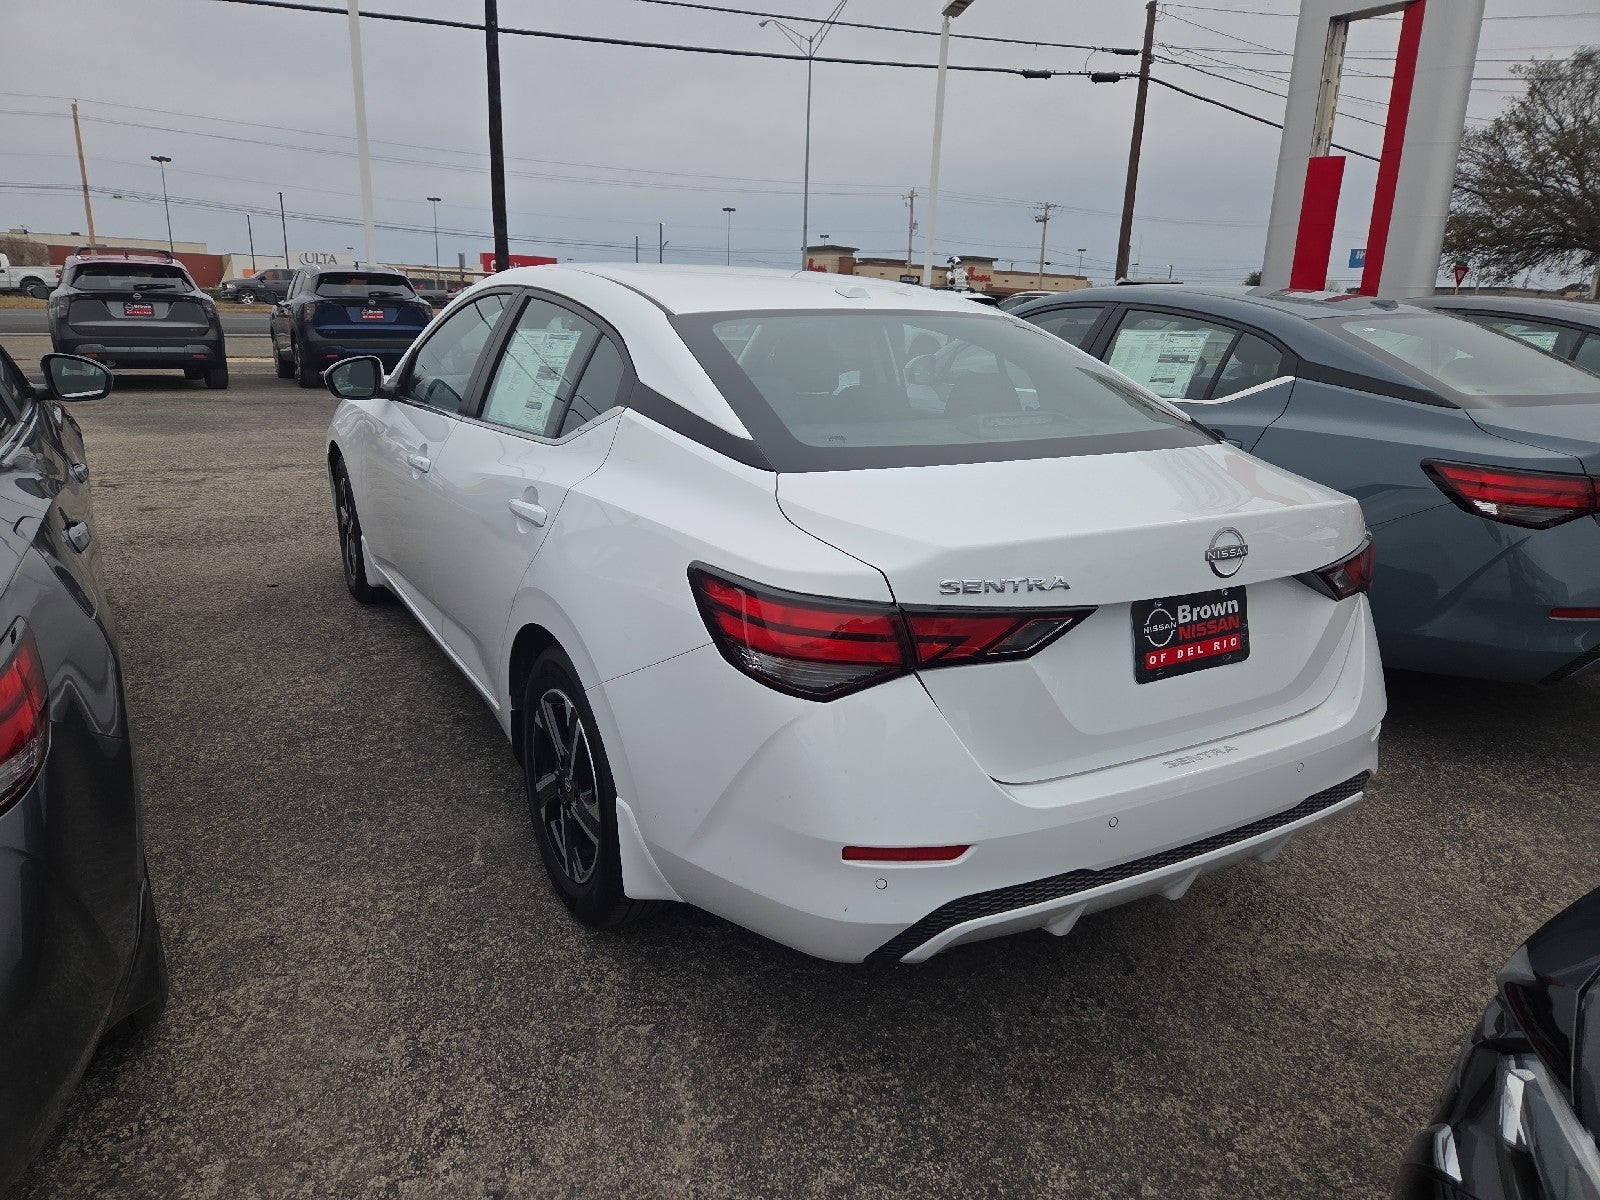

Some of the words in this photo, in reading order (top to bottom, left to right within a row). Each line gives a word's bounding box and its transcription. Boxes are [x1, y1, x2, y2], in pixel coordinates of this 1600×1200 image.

[304, 252, 338, 265] ULTA
[1207, 545, 1248, 559] NISSAN
[939, 575, 1071, 595] SENTRA
[1177, 599, 1239, 625] Brown
[1143, 621, 1177, 634] NISSAN
[1178, 615, 1240, 640] NISSAN
[1149, 653, 1167, 665] OF
[1177, 645, 1204, 659] DEL
[1213, 637, 1237, 651] RIO
[1162, 745, 1239, 768] SENTRA
